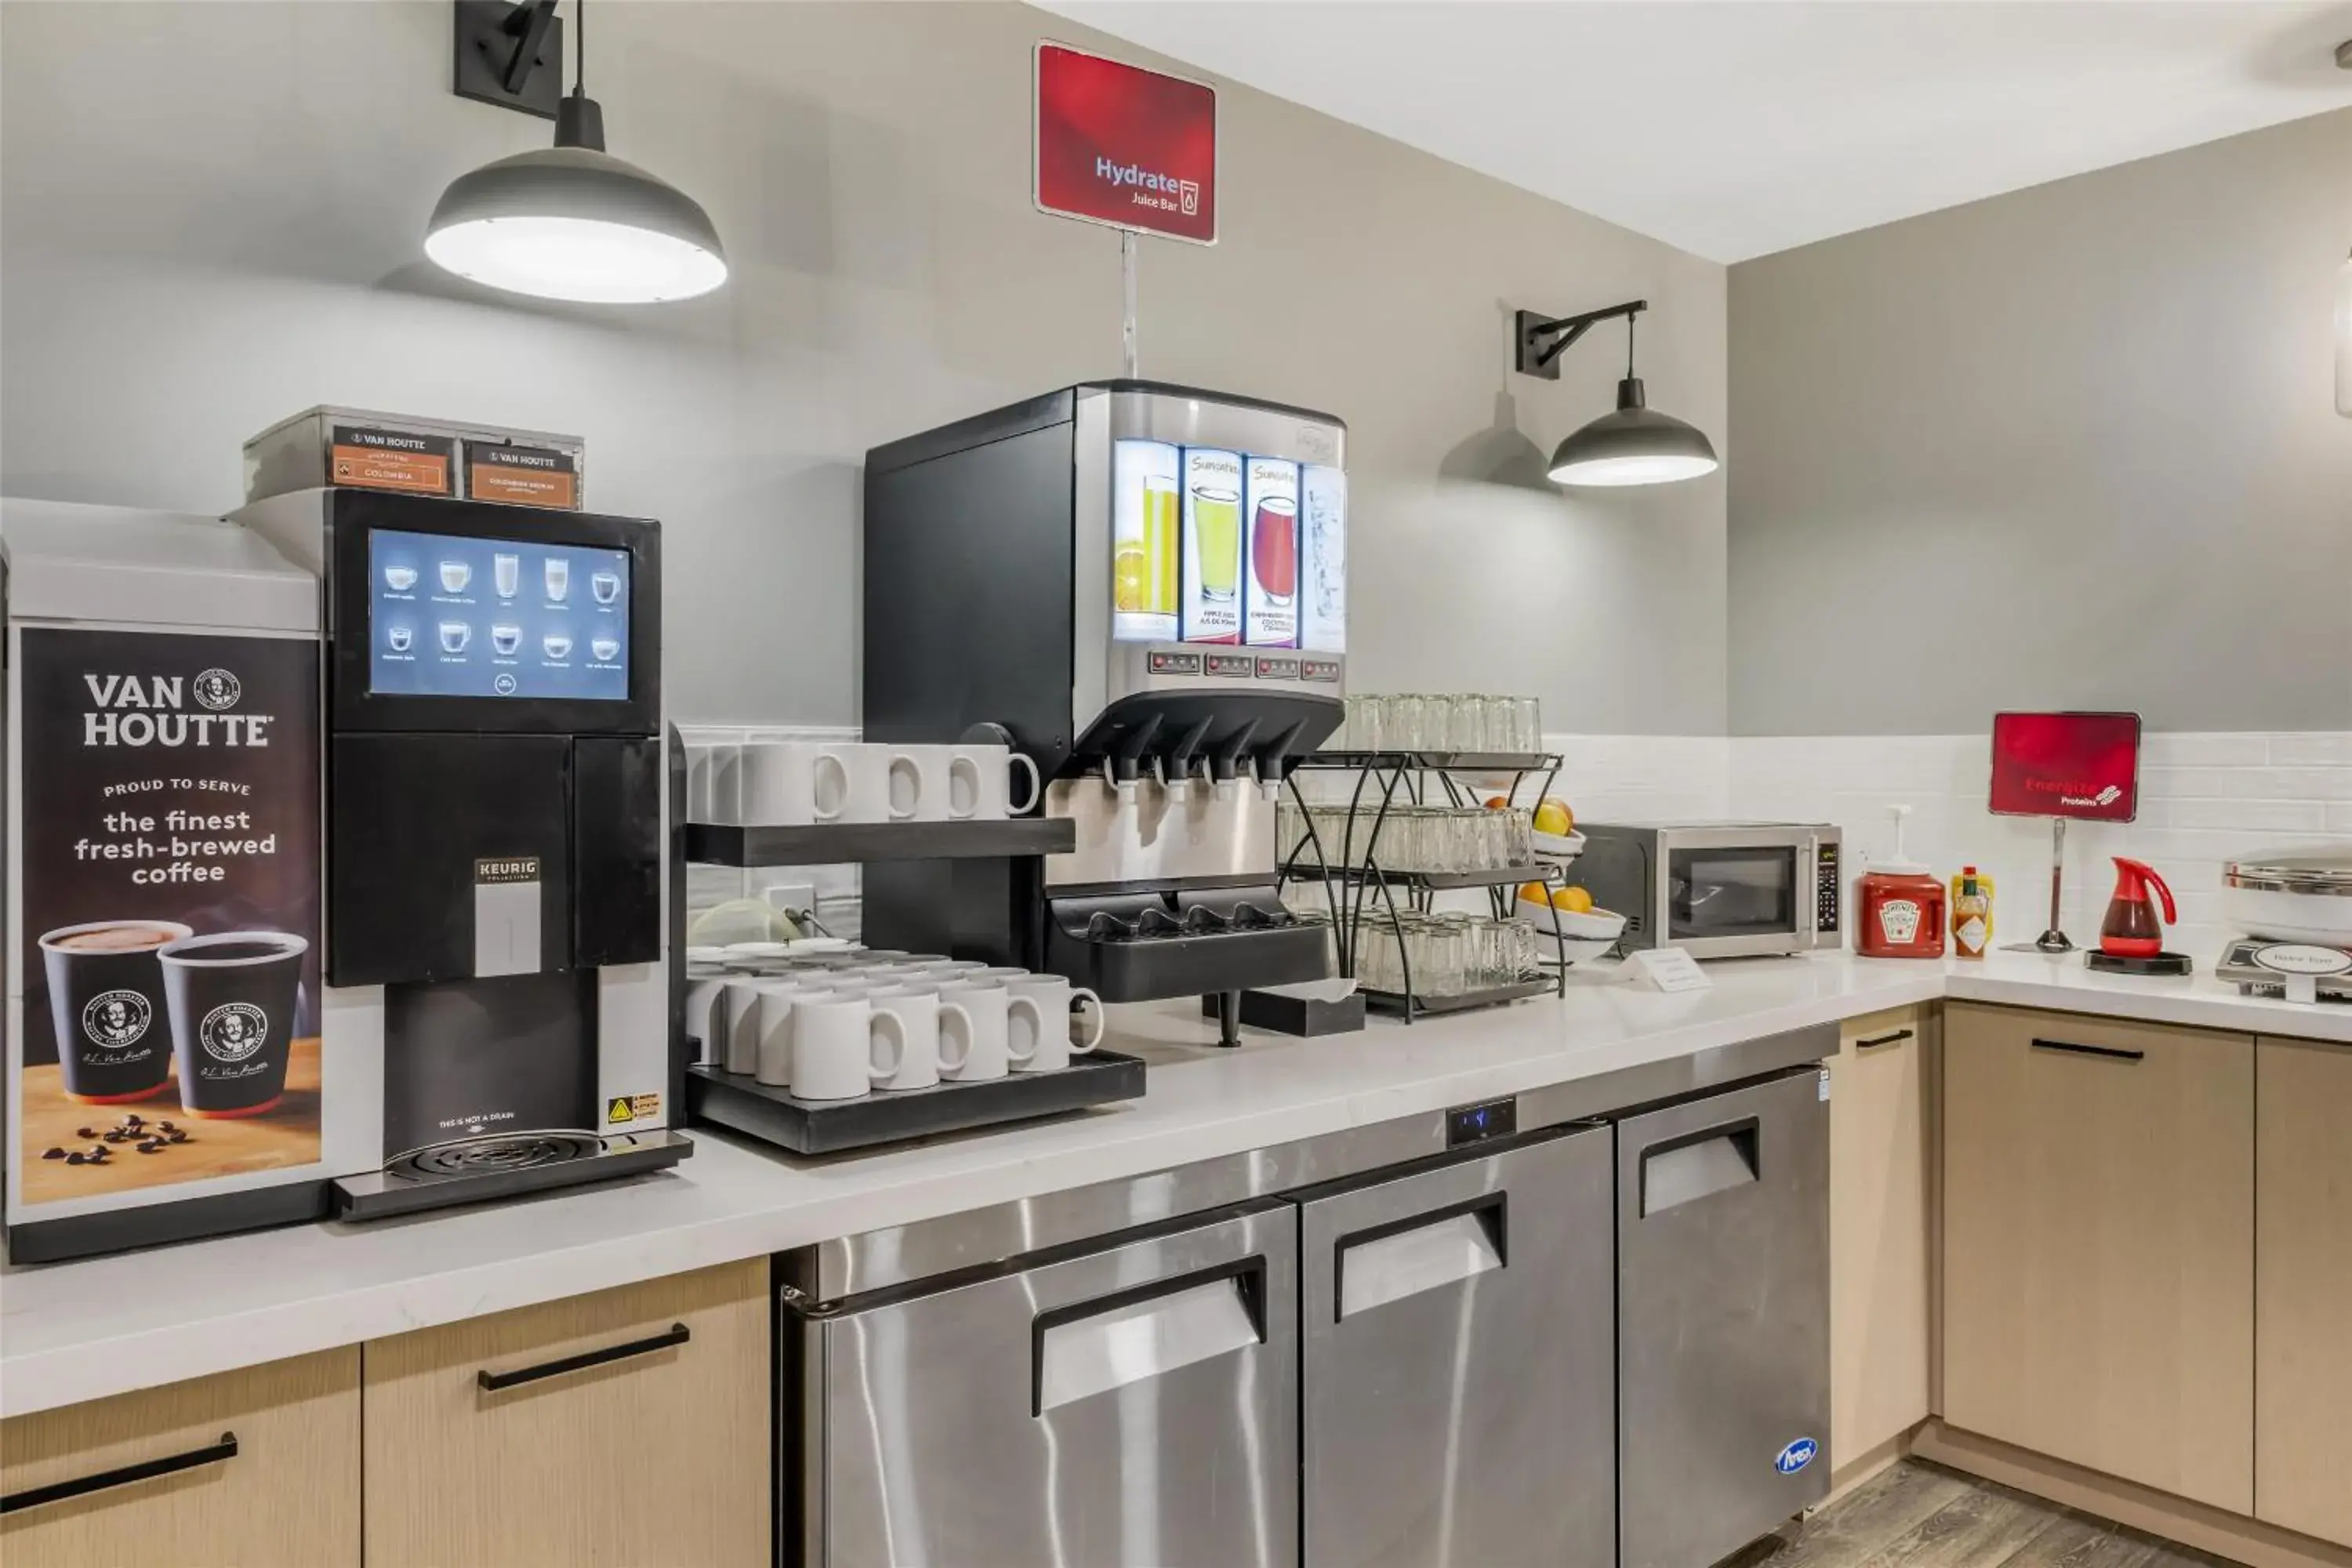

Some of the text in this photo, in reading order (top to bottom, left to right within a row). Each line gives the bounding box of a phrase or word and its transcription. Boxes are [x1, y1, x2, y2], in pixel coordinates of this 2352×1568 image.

[1096, 157, 1179, 194] Hydrate
[1131, 191, 1178, 212] Juice Bar
[363, 434, 426, 449] VAN HOUTTE
[499, 452, 556, 468] VAN HOUTTE
[84, 674, 183, 709] VAN
[84, 713, 270, 747] HOUTTE
[103, 778, 251, 797] PROUD TO SERVE
[2060, 796, 2097, 807] Proteins
[103, 809, 250, 833] the finest
[74, 833, 276, 860] fresh-brewed
[131, 861, 226, 884] coffee
[480, 862, 537, 875] KEURIG
[439, 1118, 456, 1128] THIS
[490, 1112, 515, 1120] DRAIN
